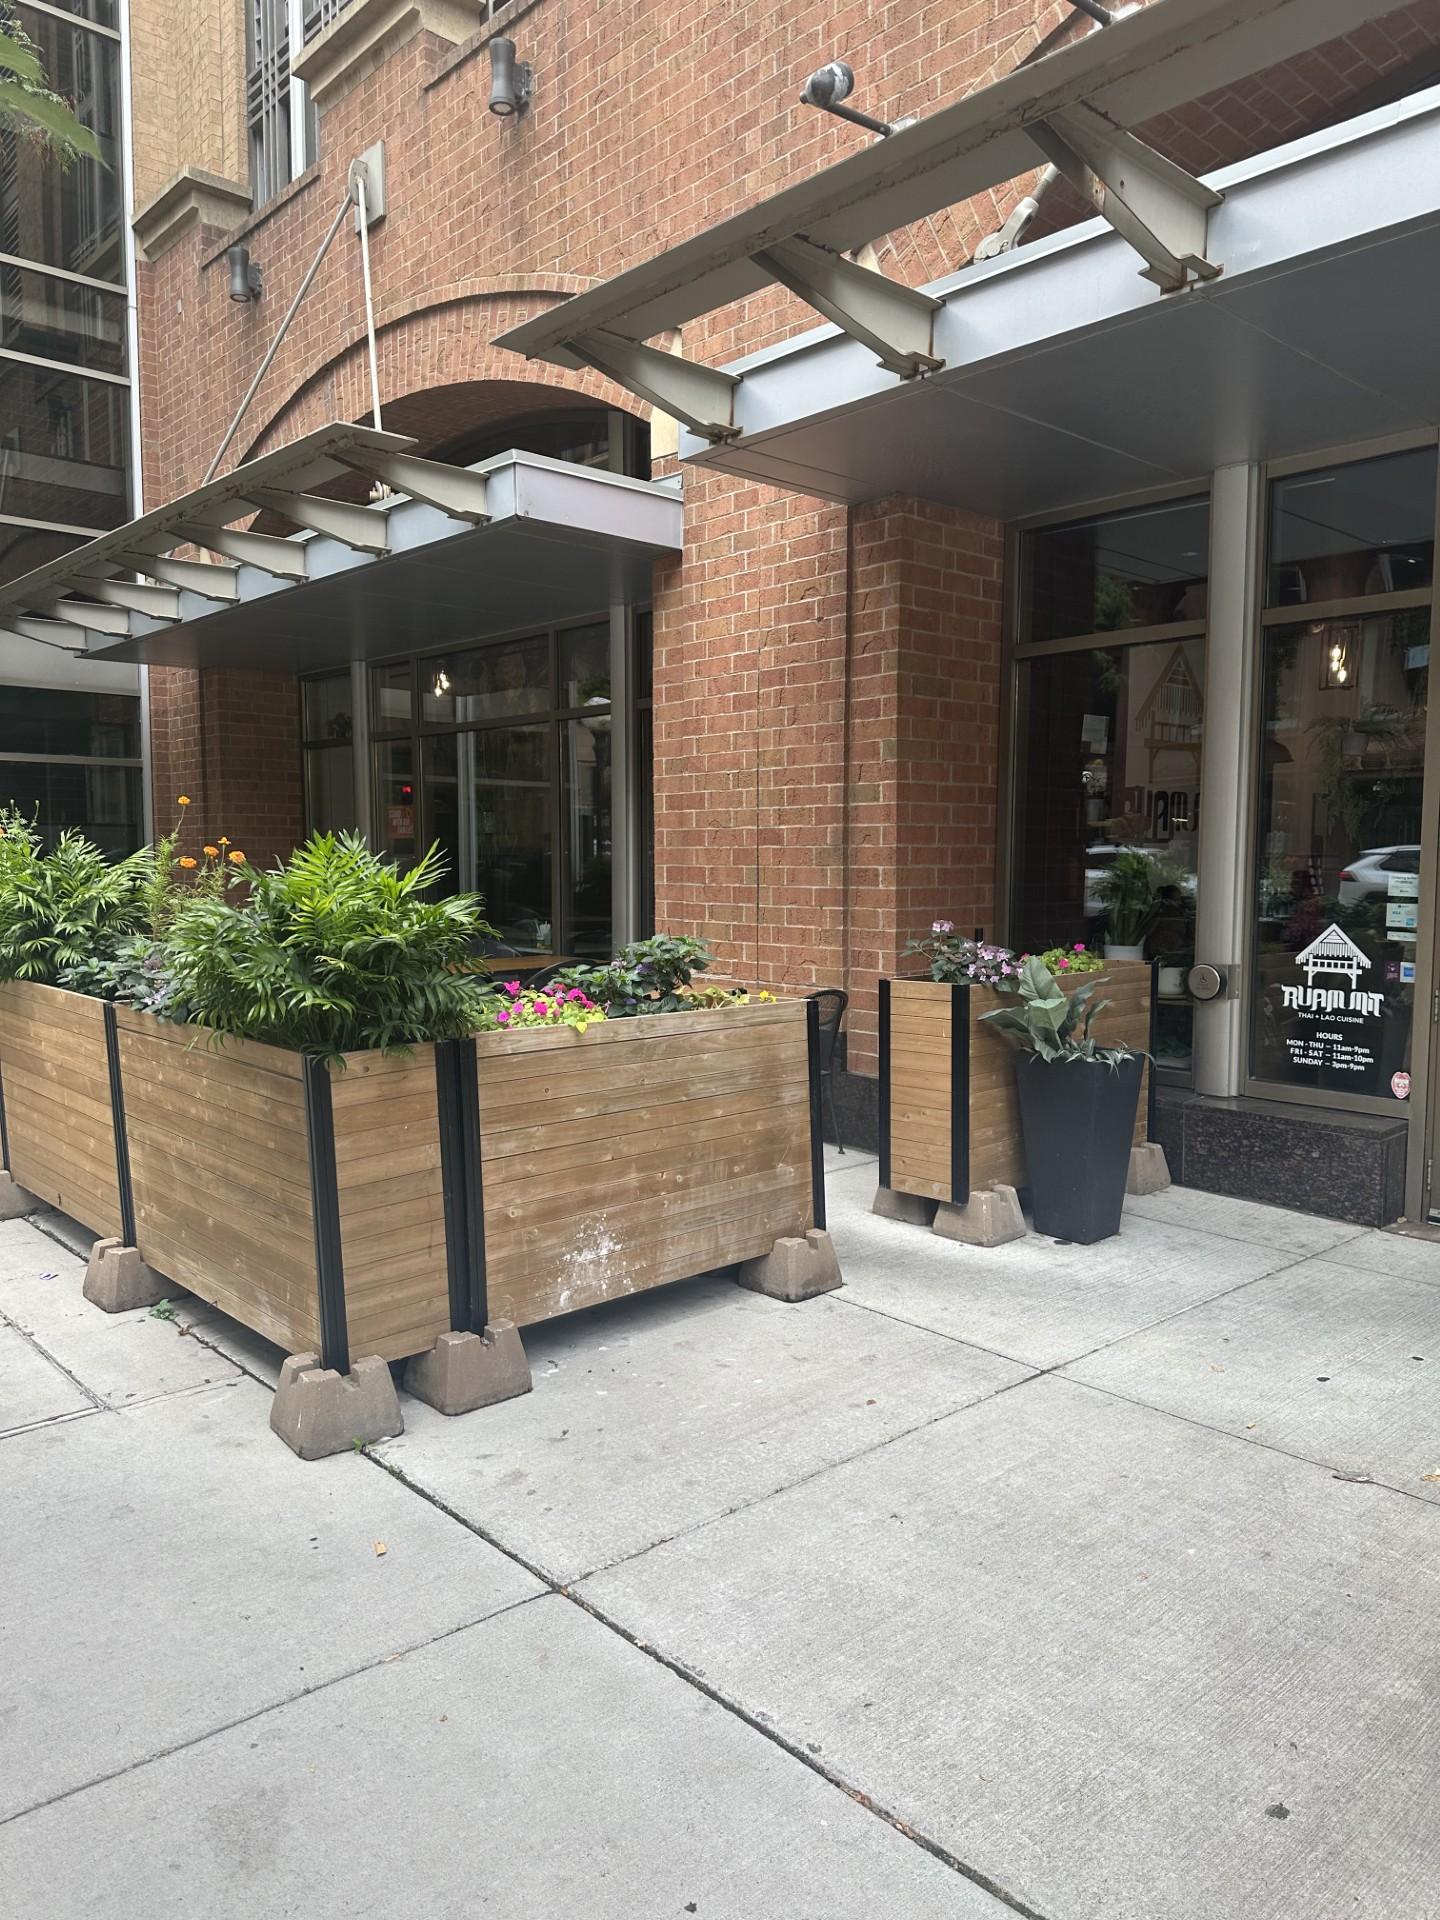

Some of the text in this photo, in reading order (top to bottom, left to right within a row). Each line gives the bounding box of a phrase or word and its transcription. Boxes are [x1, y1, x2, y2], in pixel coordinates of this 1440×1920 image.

[1282, 985, 1384, 1017] RUAM MIT
[1336, 1016, 1365, 1024] CUISINE
[1316, 1031, 1343, 1041] HOURS
[1286, 1039, 1304, 1047] MON
[1308, 1041, 1324, 1049] THU
[1332, 1044, 1370, 1054] 11am-9pm
[1290, 1047, 1303, 1055] FRI
[1308, 1049, 1324, 1058] SAT
[1332, 1052, 1374, 1063] 11am-10pm
[1292, 1057, 1323, 1066] SUNDAY
